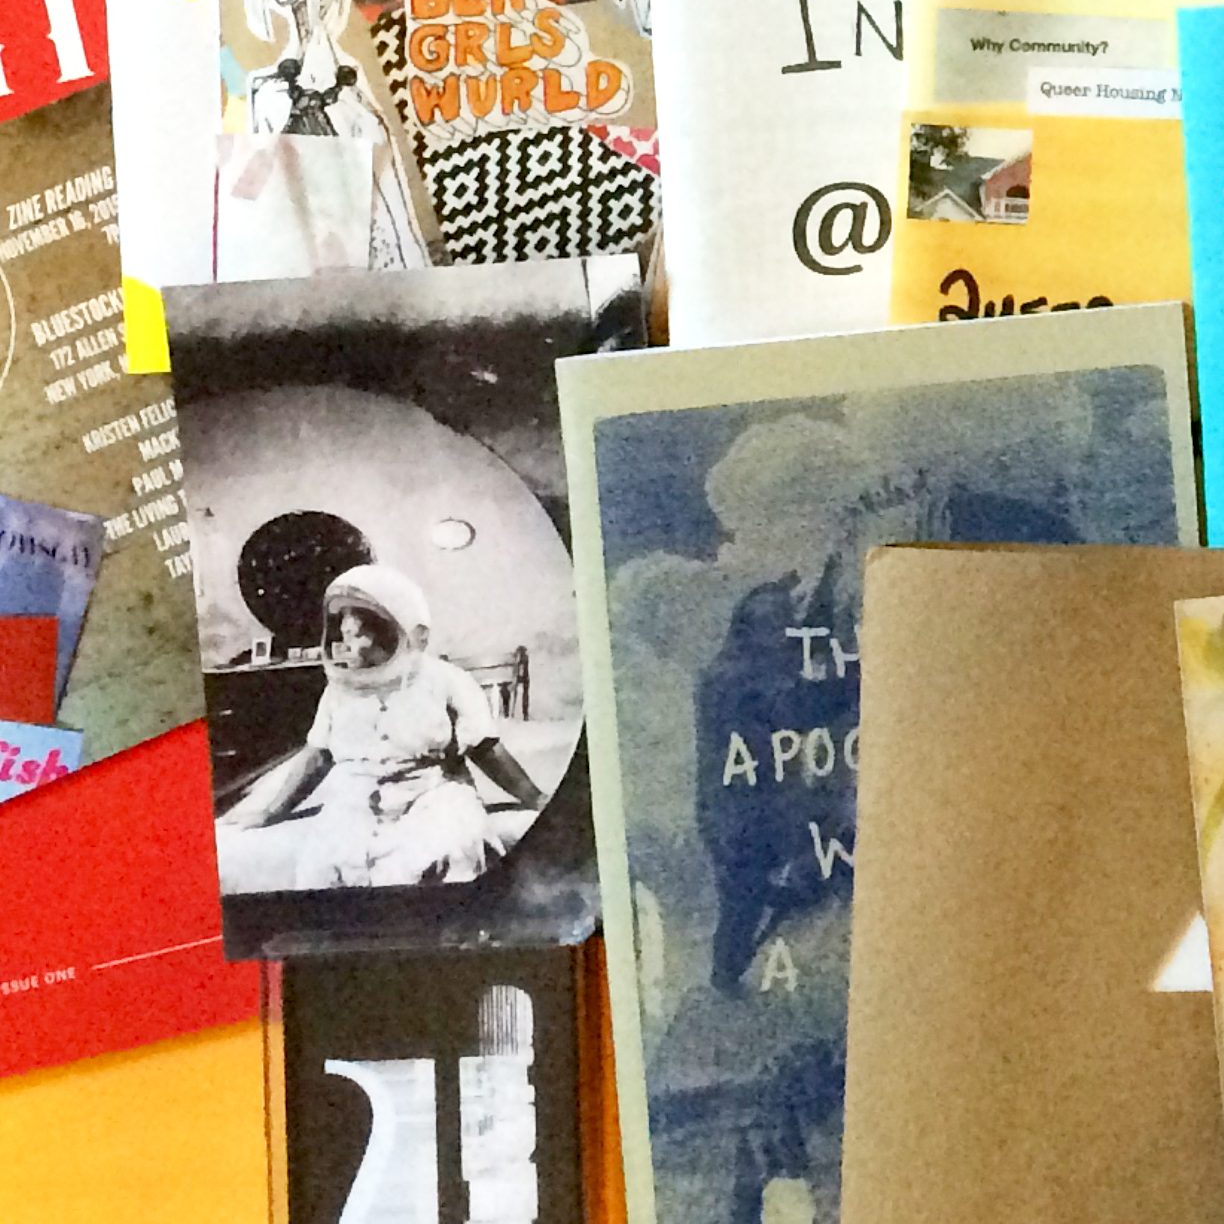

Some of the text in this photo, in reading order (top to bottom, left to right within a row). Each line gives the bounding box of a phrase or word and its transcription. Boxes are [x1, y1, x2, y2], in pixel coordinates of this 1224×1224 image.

[409, 8, 567, 72] GRLS
[970, 37, 1110, 57] Why Community?
[410, 60, 624, 123] WURLD
[1040, 81, 1167, 105] Queer Housing
[6, 166, 115, 230] ZINE READING
[0, 216, 71, 262] NOVEMBER
[792, 181, 893, 275] @
[50, 326, 119, 371] 172 ALLEN
[44, 358, 121, 405] NEW YORK,
[82, 413, 142, 454] KRISTEN
[137, 426, 182, 463] MACK
[132, 466, 172, 497] PAUL
[103, 494, 180, 540] THE LIVING
[44, 967, 76, 986] ONE
